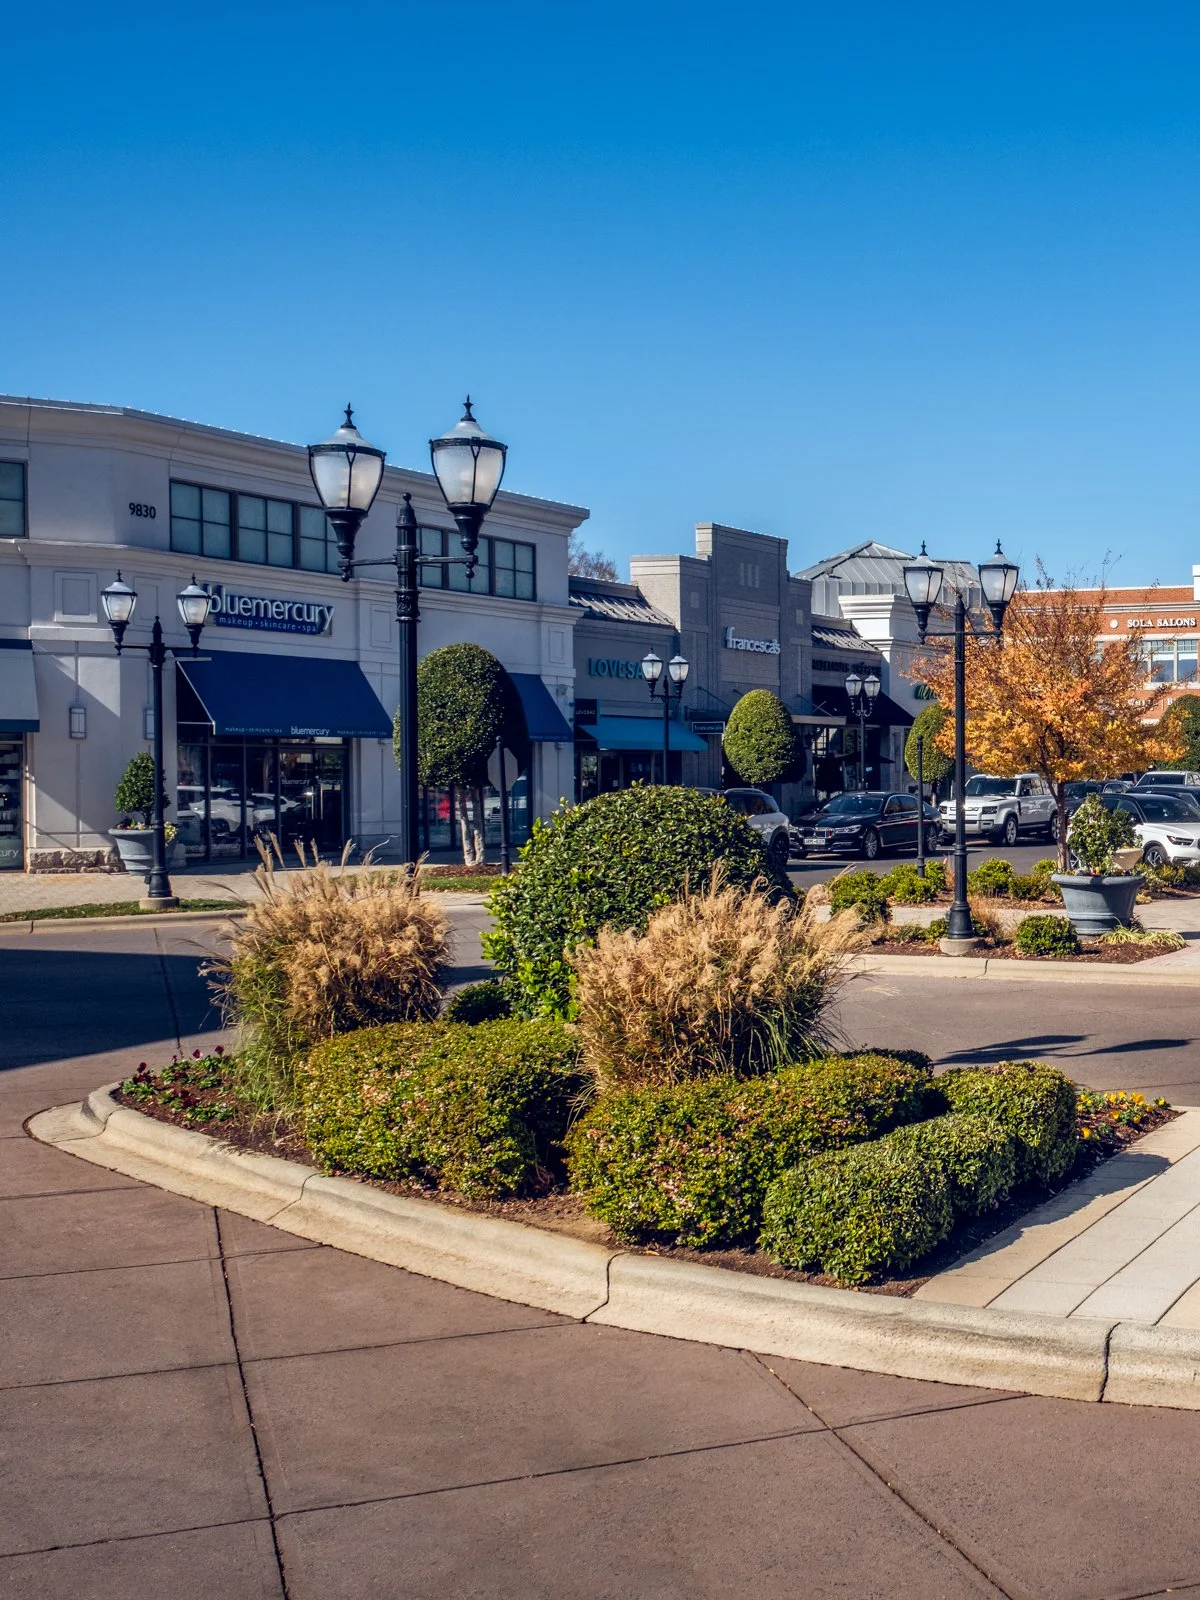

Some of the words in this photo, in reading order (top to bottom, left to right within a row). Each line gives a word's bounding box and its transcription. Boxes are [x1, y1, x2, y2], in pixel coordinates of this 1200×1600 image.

[129, 502, 156, 519] 9830
[207, 584, 334, 630] bluemercury
[220, 616, 253, 627] makeup
[260, 620, 296, 630] skincare
[1127, 619, 1153, 627] SOLA
[1157, 618, 1197, 627] SALONS
[726, 626, 780, 654] francesca's
[588, 658, 643, 680] LOVESA
[290, 726, 330, 736] bluemercury
